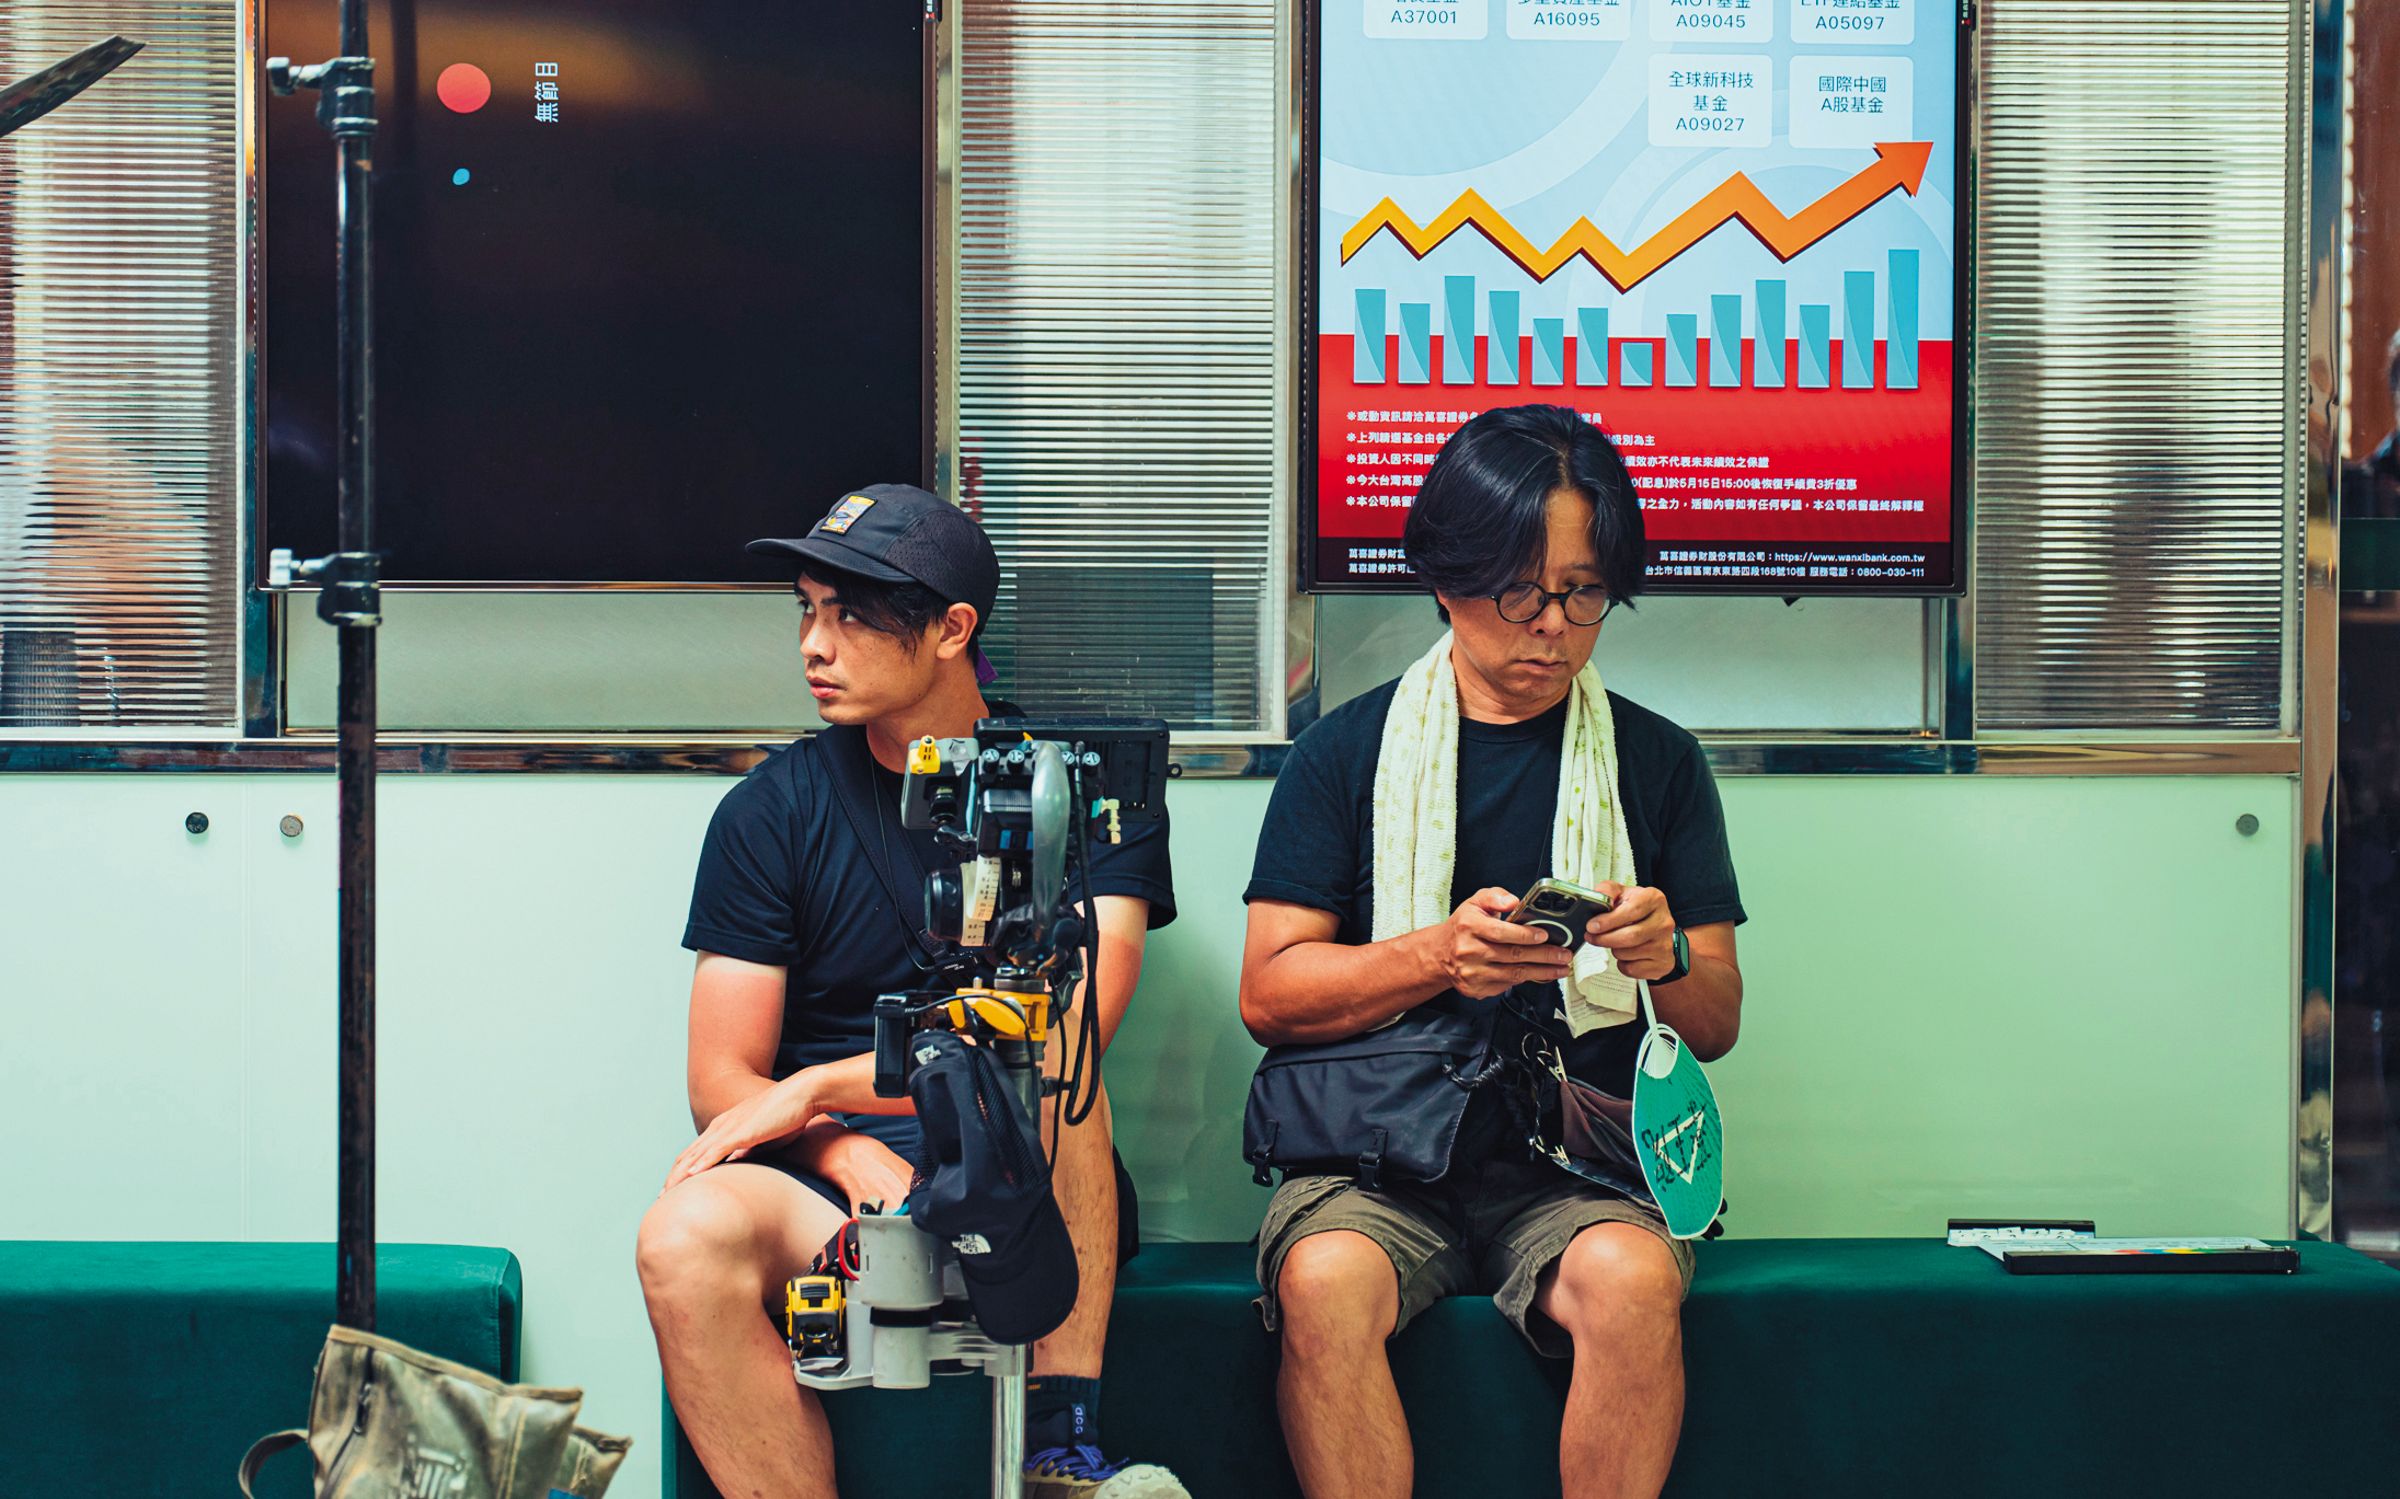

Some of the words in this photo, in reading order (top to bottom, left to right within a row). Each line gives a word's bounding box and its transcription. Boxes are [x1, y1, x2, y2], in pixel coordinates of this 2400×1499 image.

[1391, 10, 1456, 24] A37001
[1534, 12, 1600, 26] A16095
[1676, 14, 1745, 28] A09045
[1816, 16, 1884, 30] A05097
[1670, 71, 1753, 88] 全球新科技
[1819, 76, 1886, 93] 國際中國
[533, 61, 560, 123] 無節目
[1694, 95, 1727, 111] 基金
[1821, 97, 1883, 113] A股基金
[1676, 117, 1744, 131] A09027
